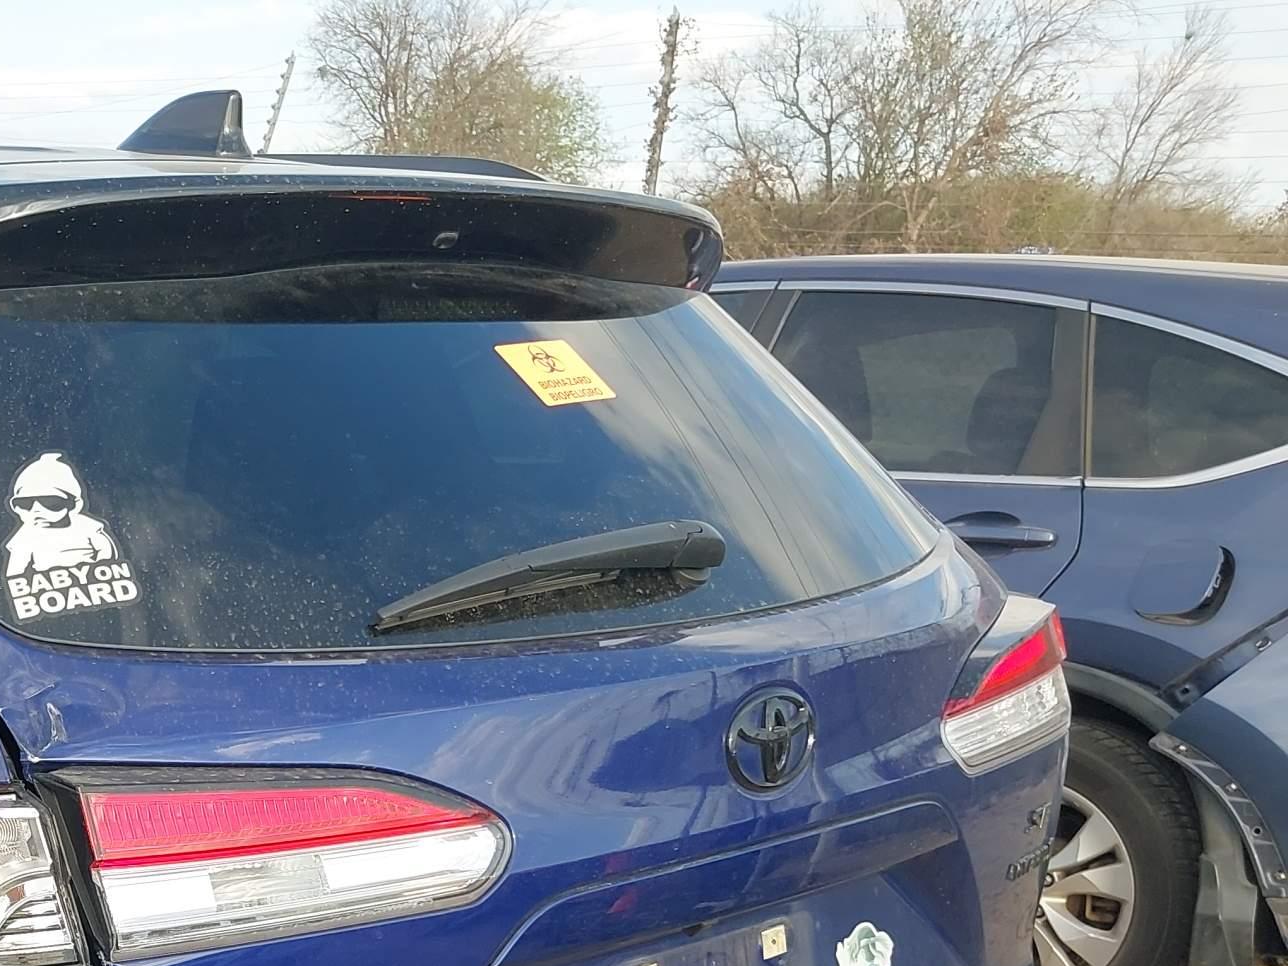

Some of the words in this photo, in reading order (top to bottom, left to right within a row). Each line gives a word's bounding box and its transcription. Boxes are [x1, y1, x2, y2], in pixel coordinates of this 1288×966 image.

[538, 376, 592, 390] BIOHAZARD
[549, 388, 604, 401] BIOPELIGRO
[7, 565, 90, 598] BABY
[94, 563, 131, 580] ON
[13, 579, 138, 620] BOARD
